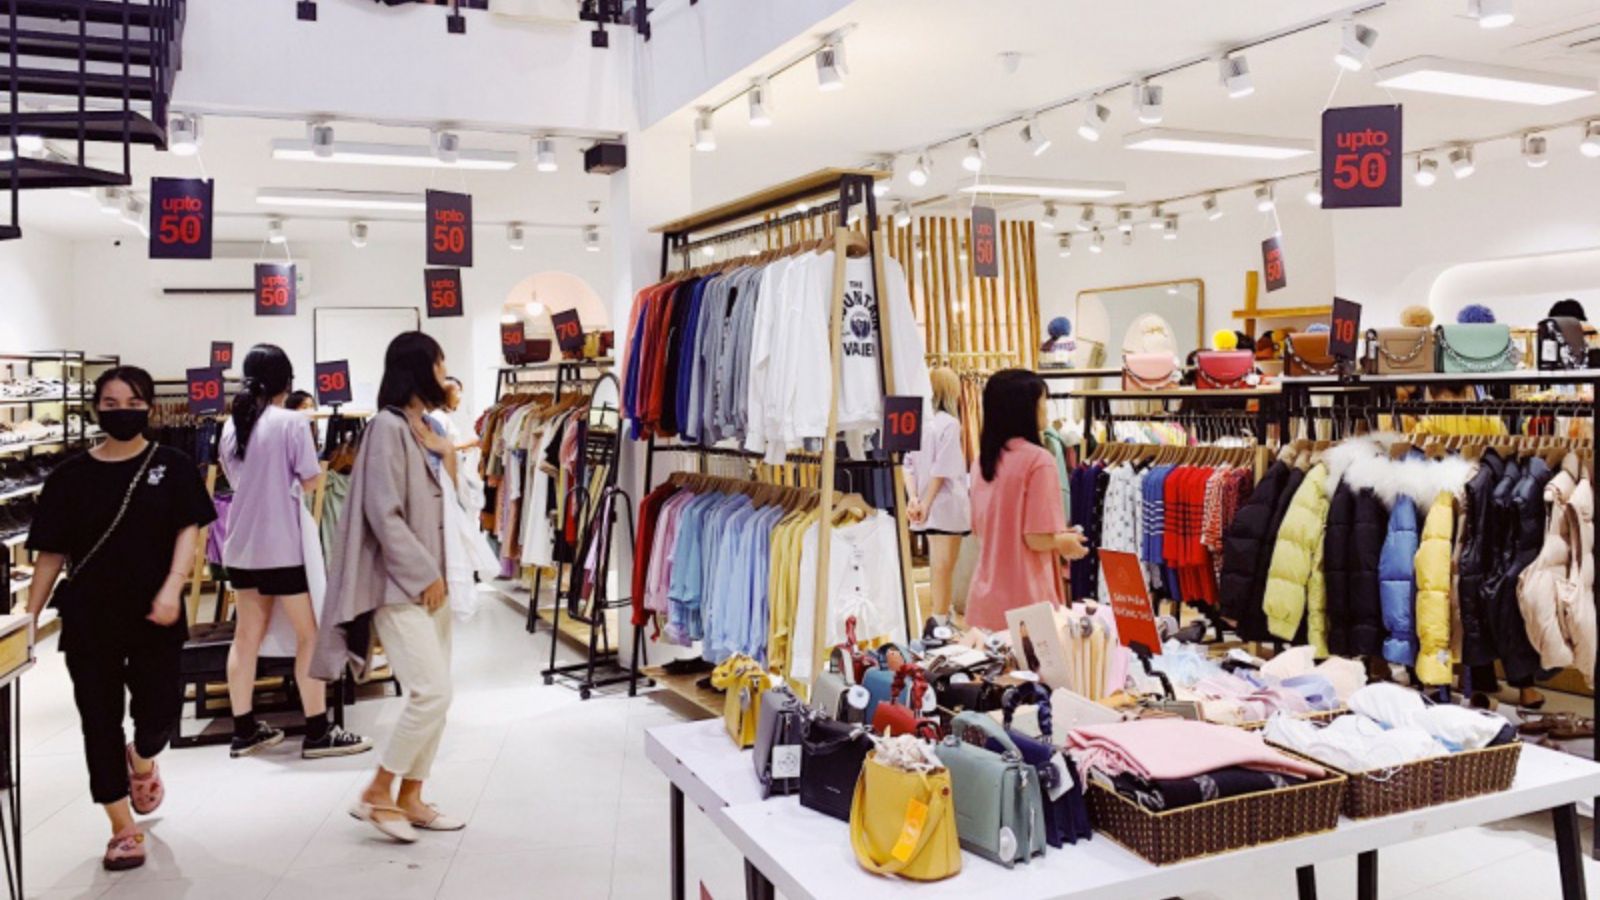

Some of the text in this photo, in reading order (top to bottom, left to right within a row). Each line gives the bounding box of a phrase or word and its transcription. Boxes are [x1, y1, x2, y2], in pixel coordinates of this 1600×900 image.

[1336, 128, 1389, 151] upto
[162, 196, 202, 213] upto
[434, 208, 465, 223] upto
